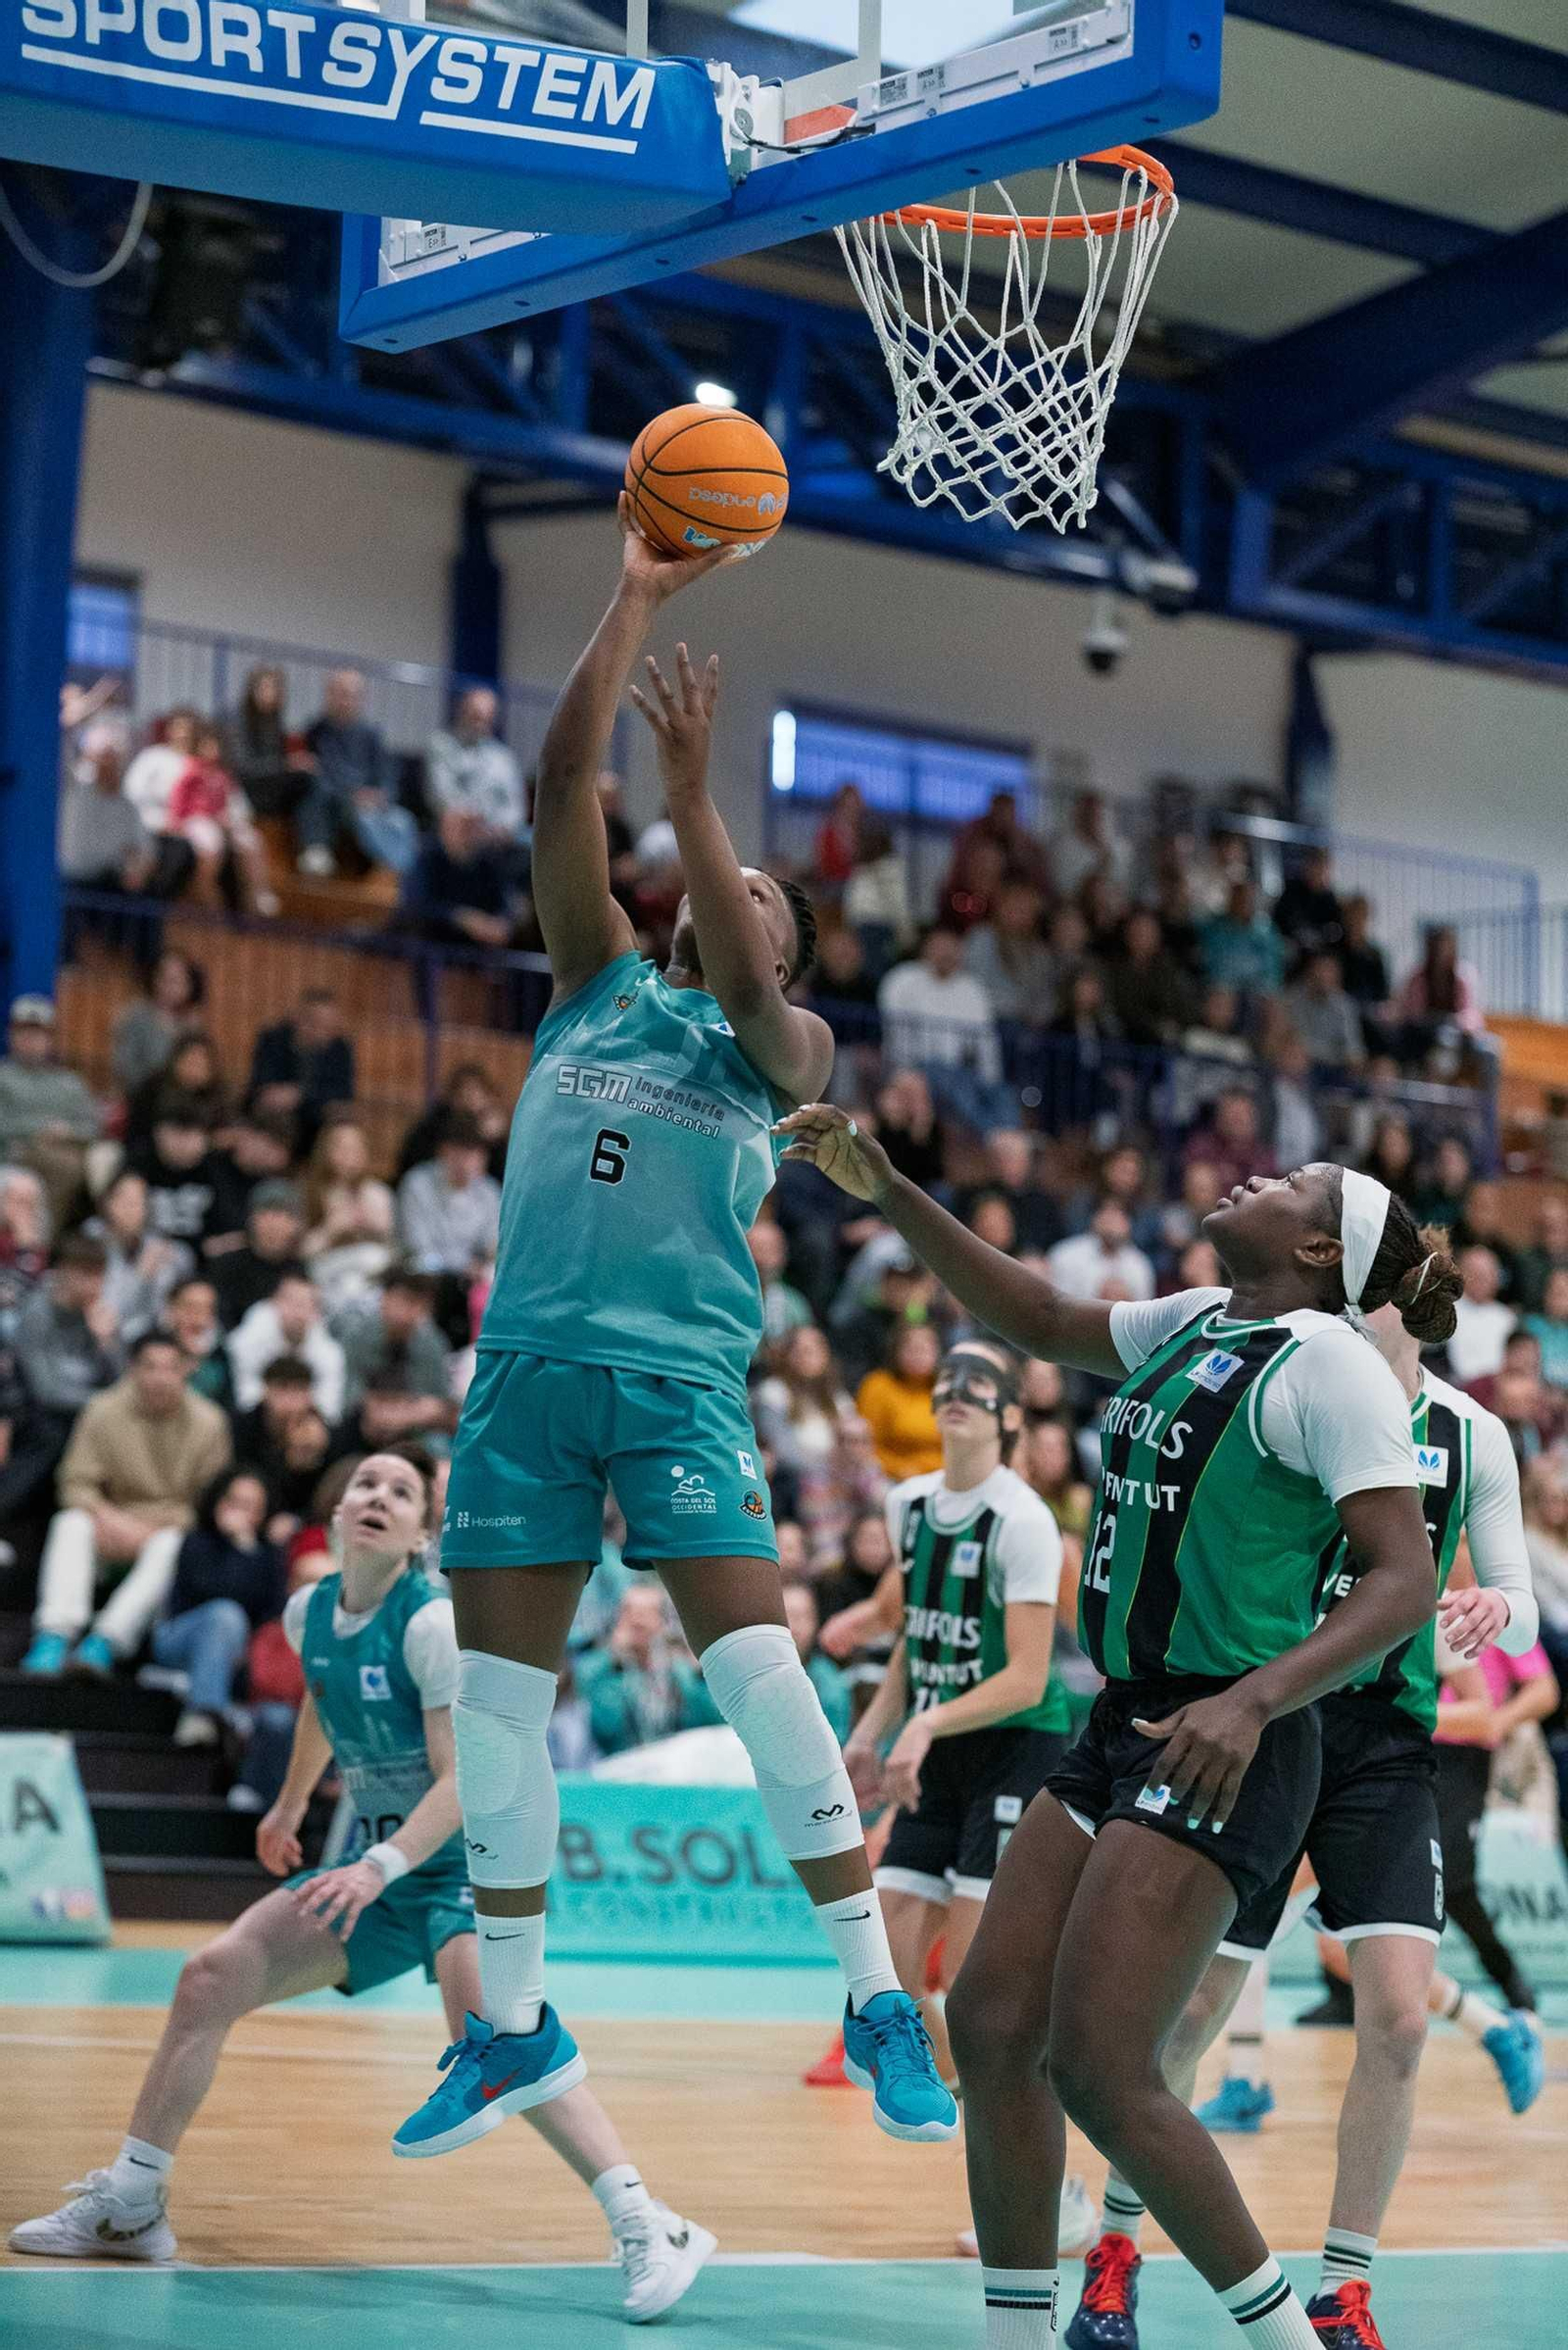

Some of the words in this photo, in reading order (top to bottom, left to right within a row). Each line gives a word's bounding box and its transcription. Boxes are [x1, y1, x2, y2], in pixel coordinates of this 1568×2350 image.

[556, 1063, 633, 1103] SGM
[627, 1098, 720, 1140] ambiental
[589, 1127, 632, 1187] 6
[1101, 1395, 1194, 1460] RIFOLS
[1102, 1465, 1182, 1512] ENTUT
[471, 1515, 526, 1528] Hospiten
[1084, 1510, 1117, 1594] 12
